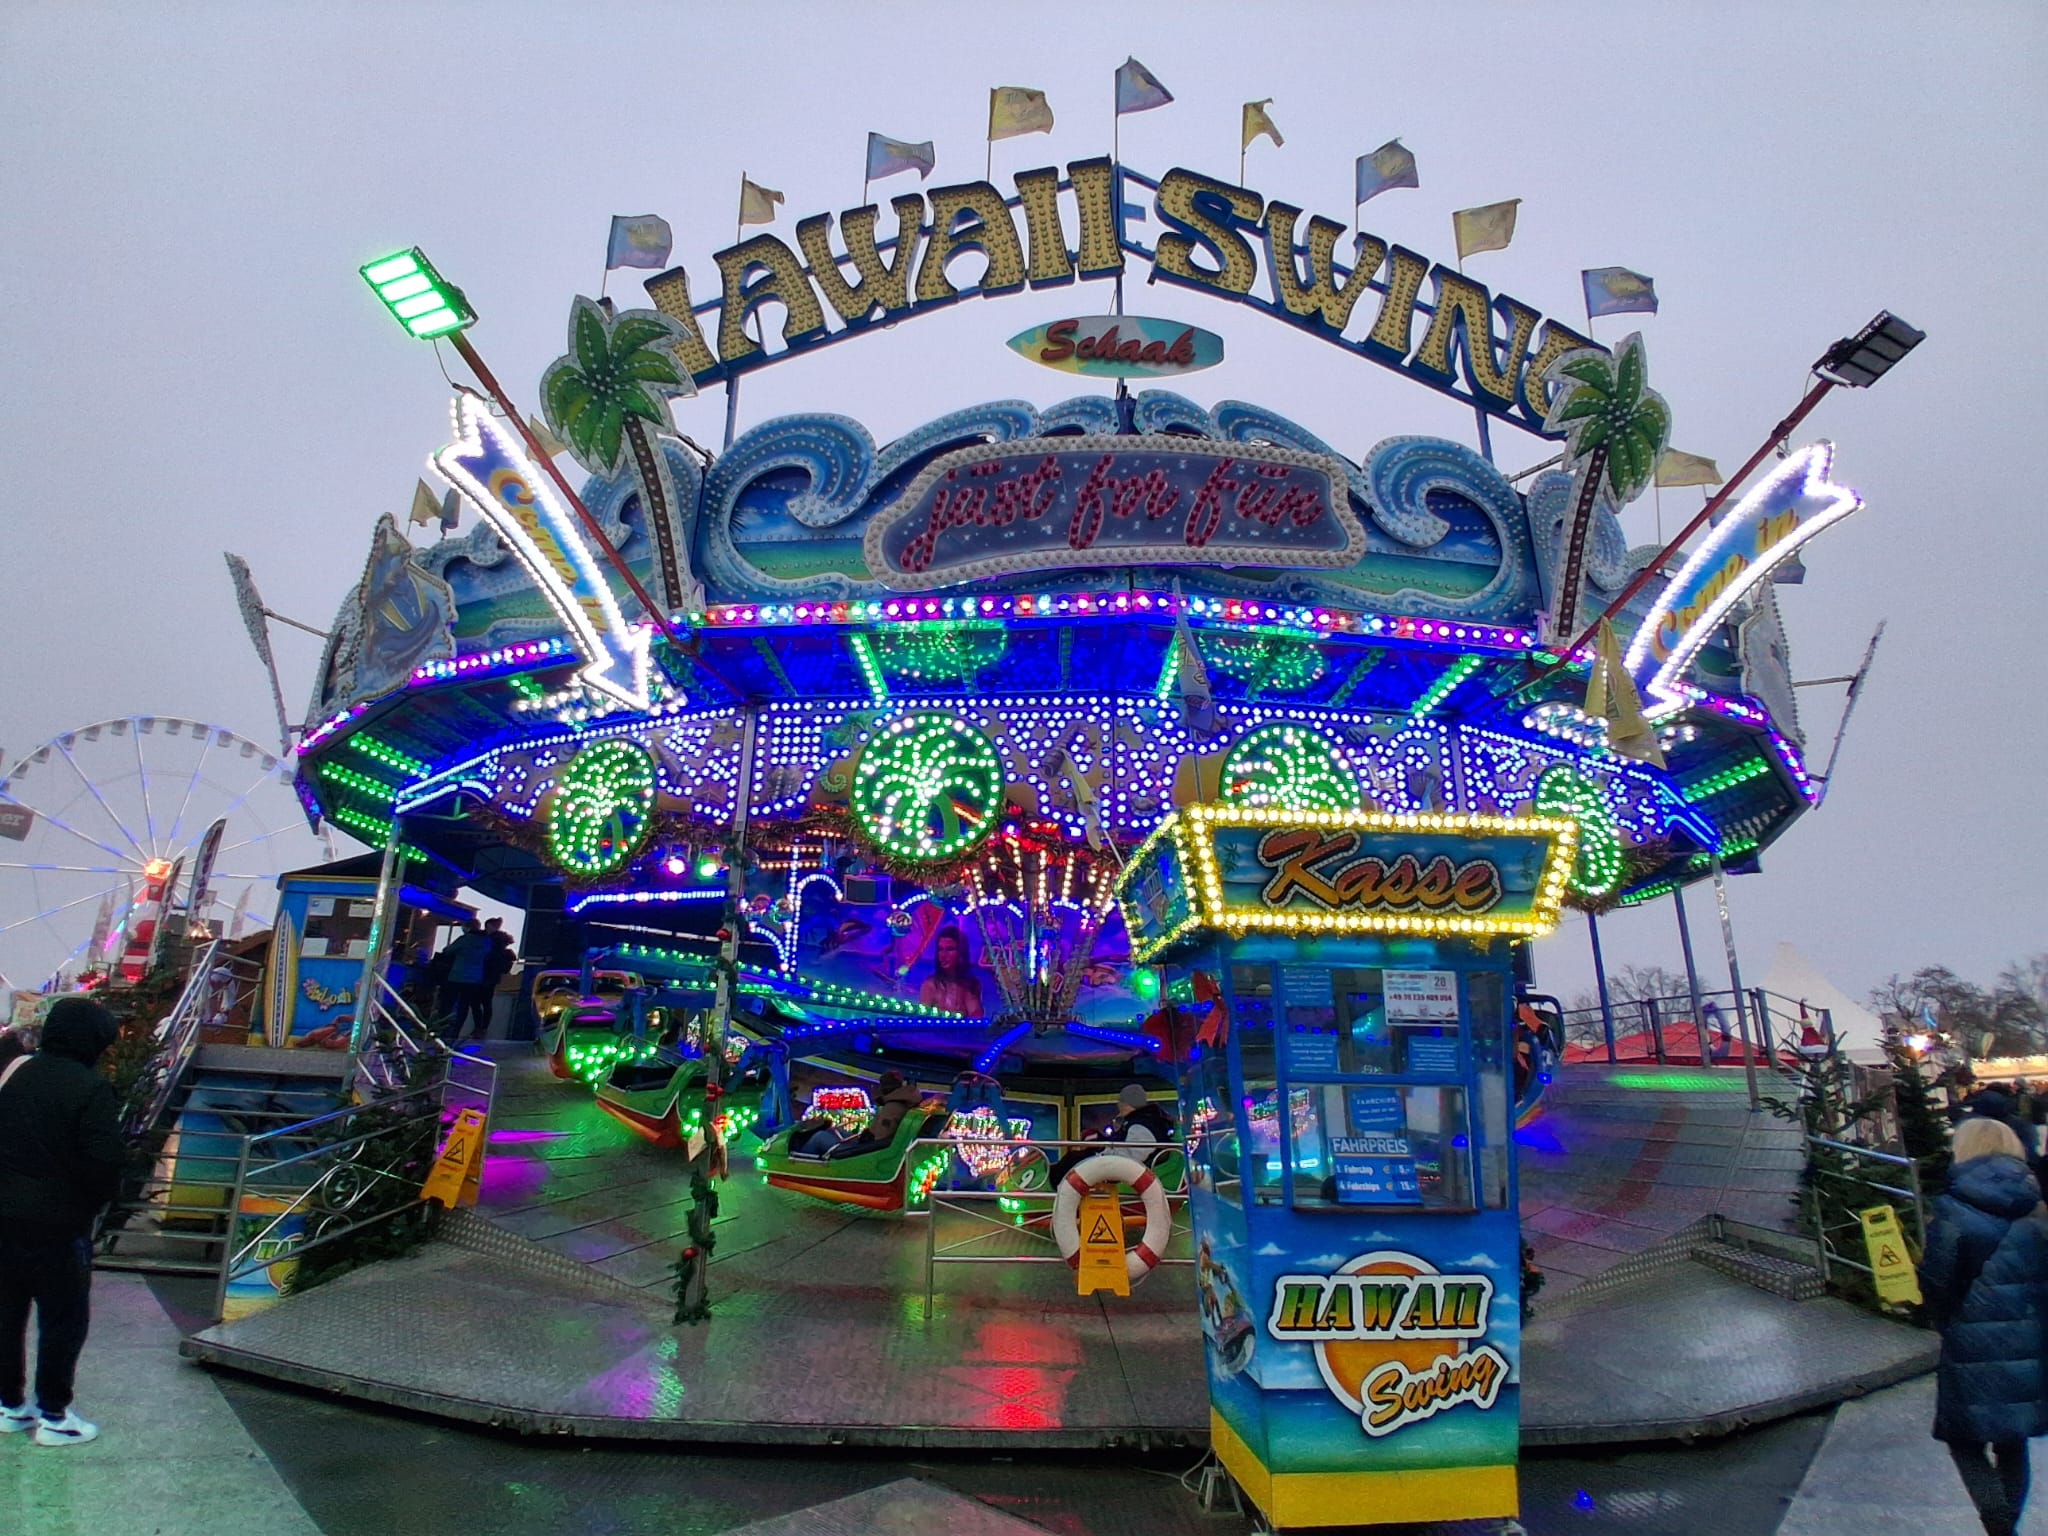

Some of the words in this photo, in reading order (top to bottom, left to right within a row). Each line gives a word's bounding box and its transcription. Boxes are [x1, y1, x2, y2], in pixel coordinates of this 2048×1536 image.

[1040, 319, 1197, 364] Schaak
[1067, 453, 1180, 551] for
[1259, 827, 1500, 913] Kasse
[1332, 1138, 1409, 1154] FAHRPREIS
[1276, 1283, 1486, 1331] HAWAII
[1367, 1352, 1501, 1427] Swing
